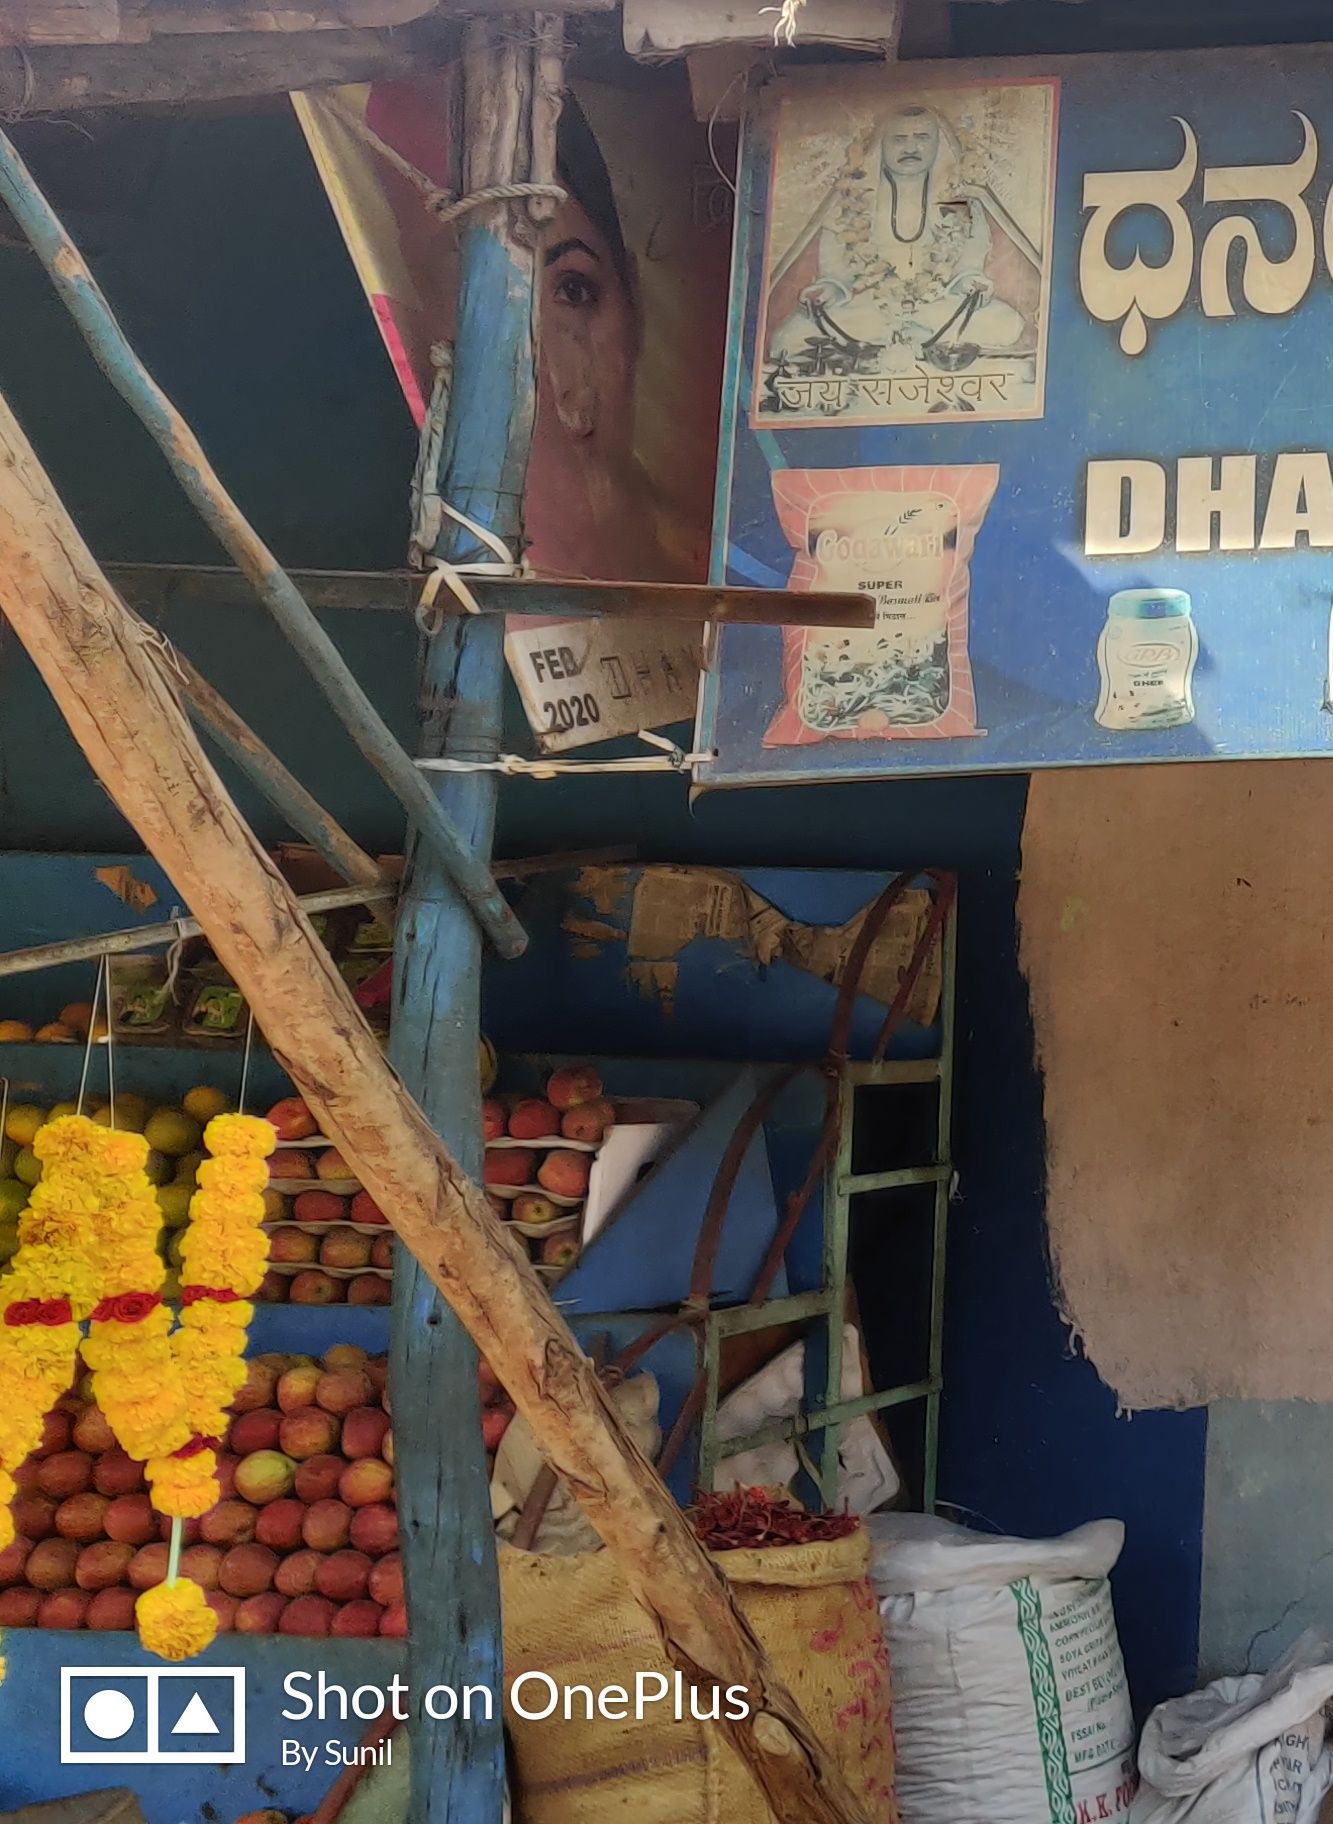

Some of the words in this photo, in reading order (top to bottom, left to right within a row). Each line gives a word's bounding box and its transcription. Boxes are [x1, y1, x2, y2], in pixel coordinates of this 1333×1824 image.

[776, 378, 848, 409] जय
[857, 579, 904, 591] SUPER
[543, 692, 601, 733] 2020
